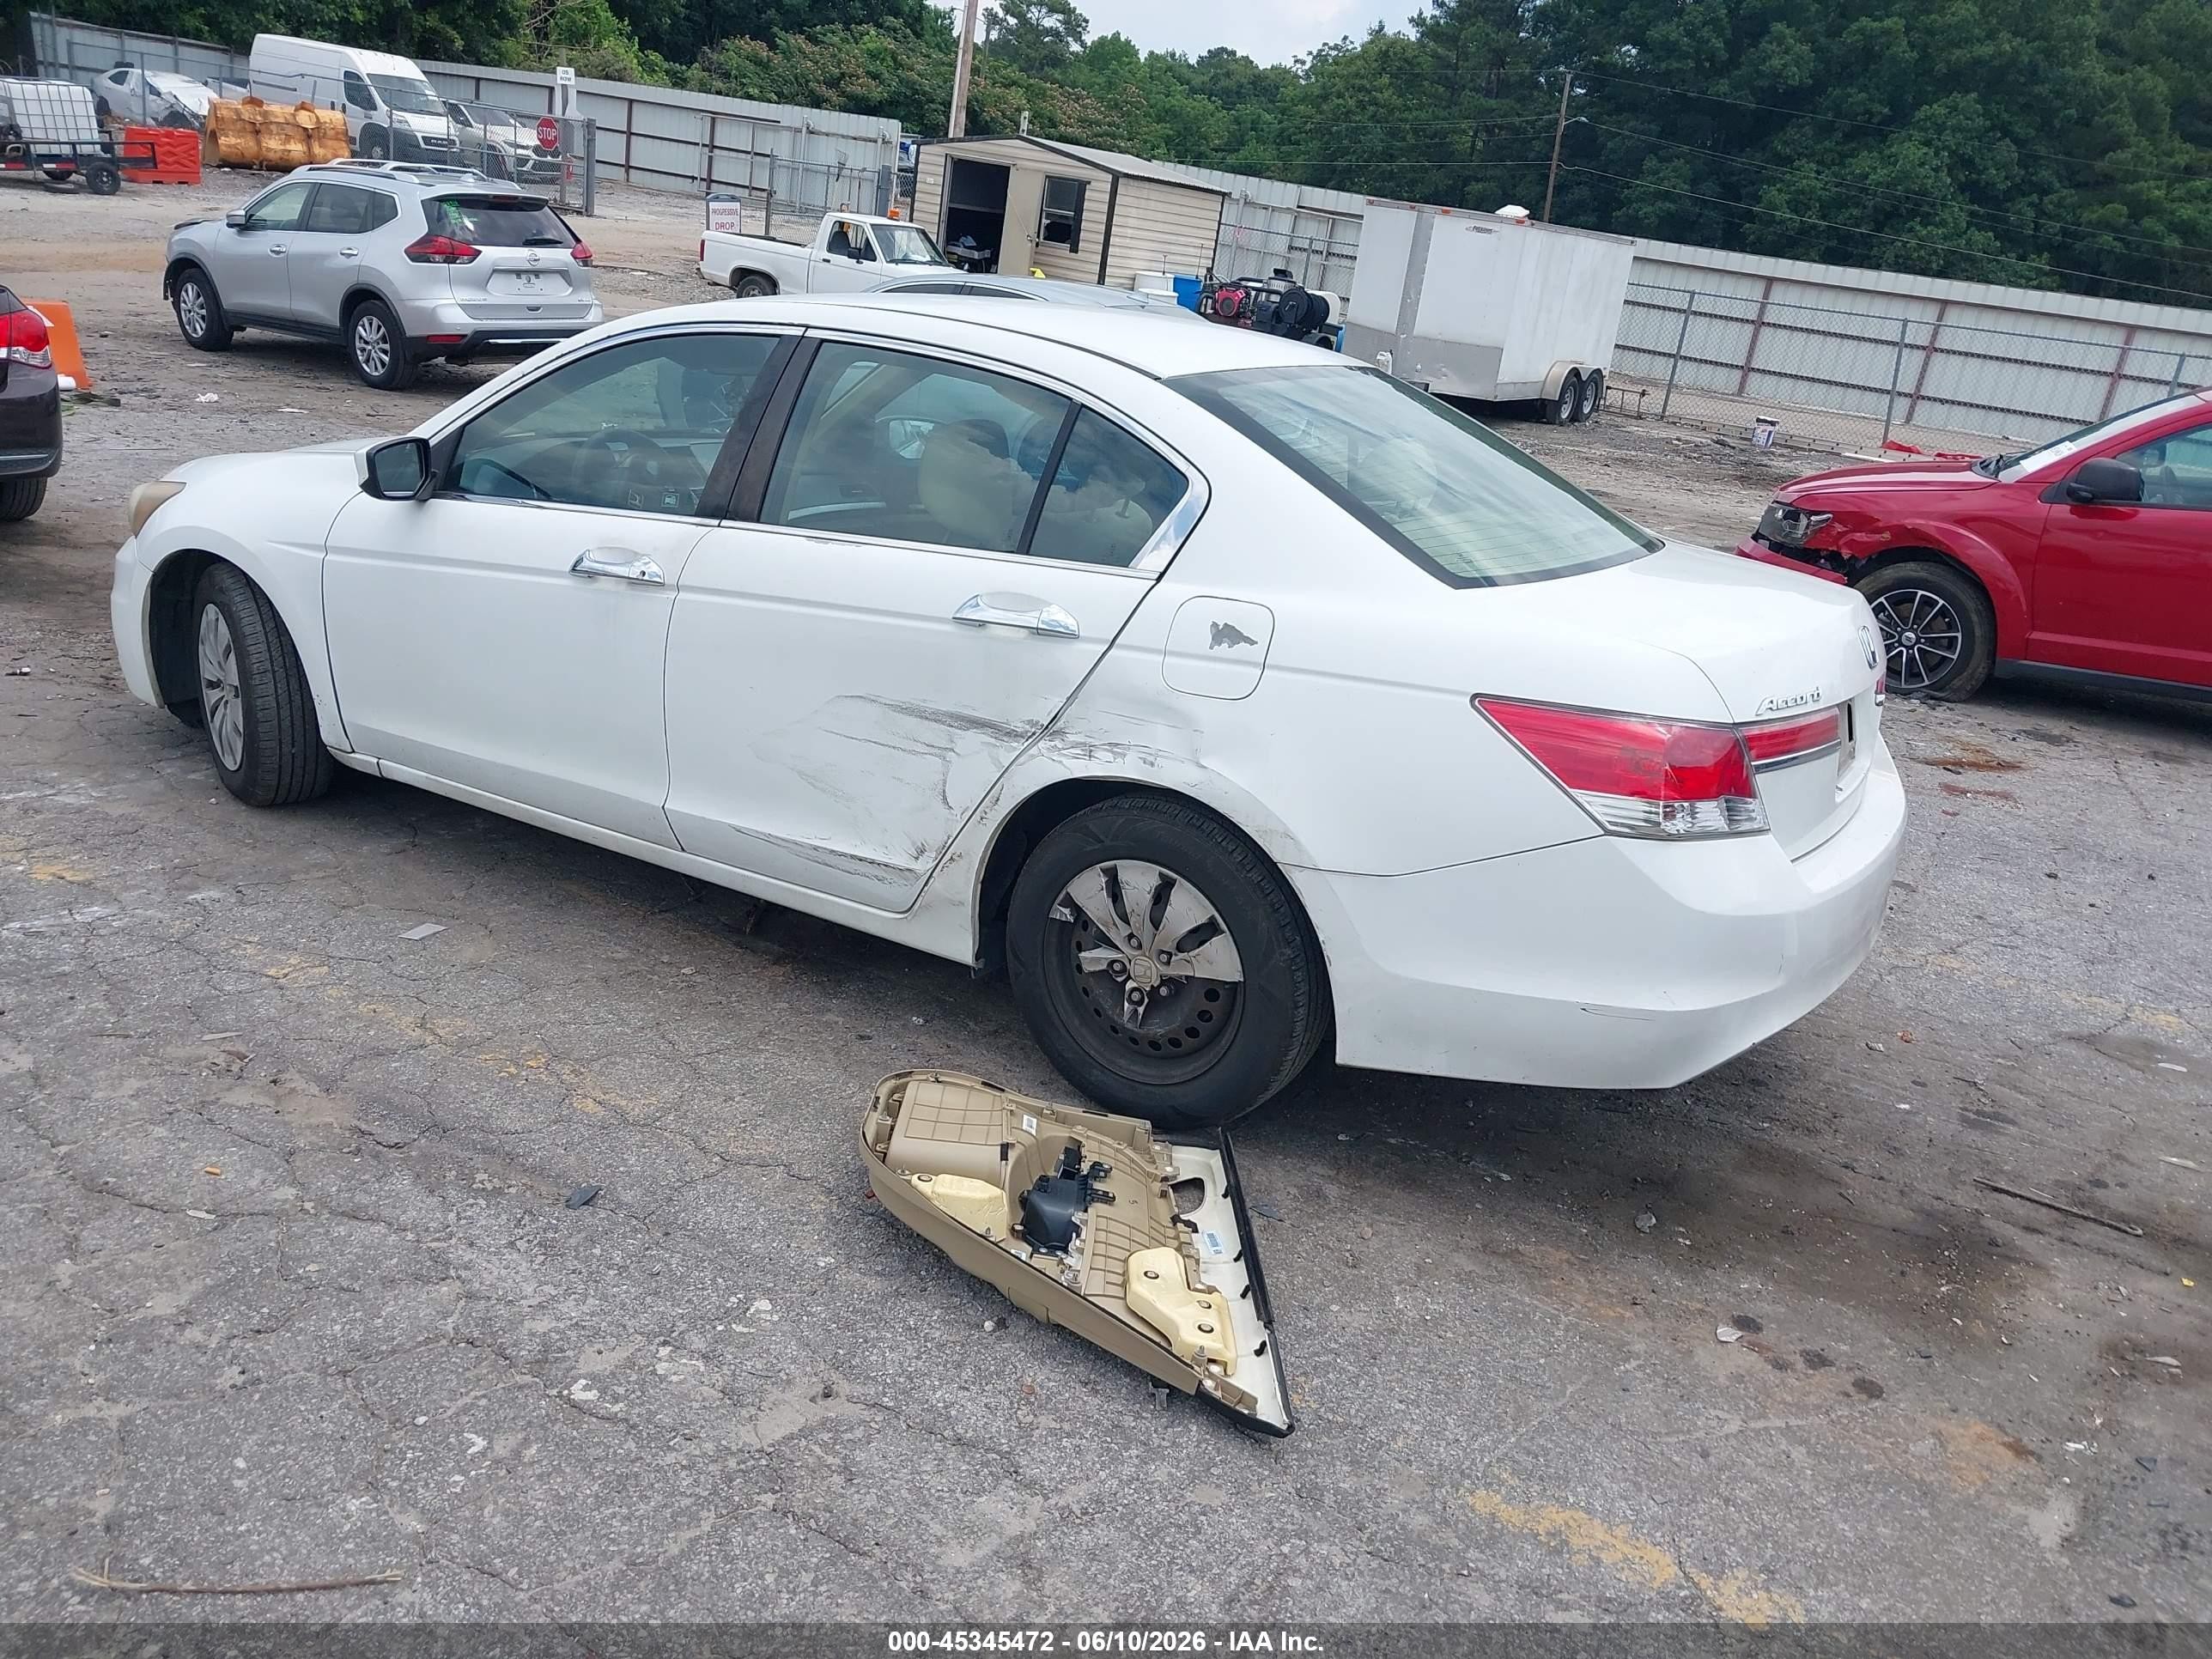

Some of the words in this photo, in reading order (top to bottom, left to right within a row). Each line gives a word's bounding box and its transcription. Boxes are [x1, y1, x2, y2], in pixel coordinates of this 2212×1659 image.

[538, 126, 557, 141] STOP
[711, 208, 738, 216] PROGRESSIVE
[714, 222, 735, 231] DROP
[1754, 686, 1821, 716] Accord
